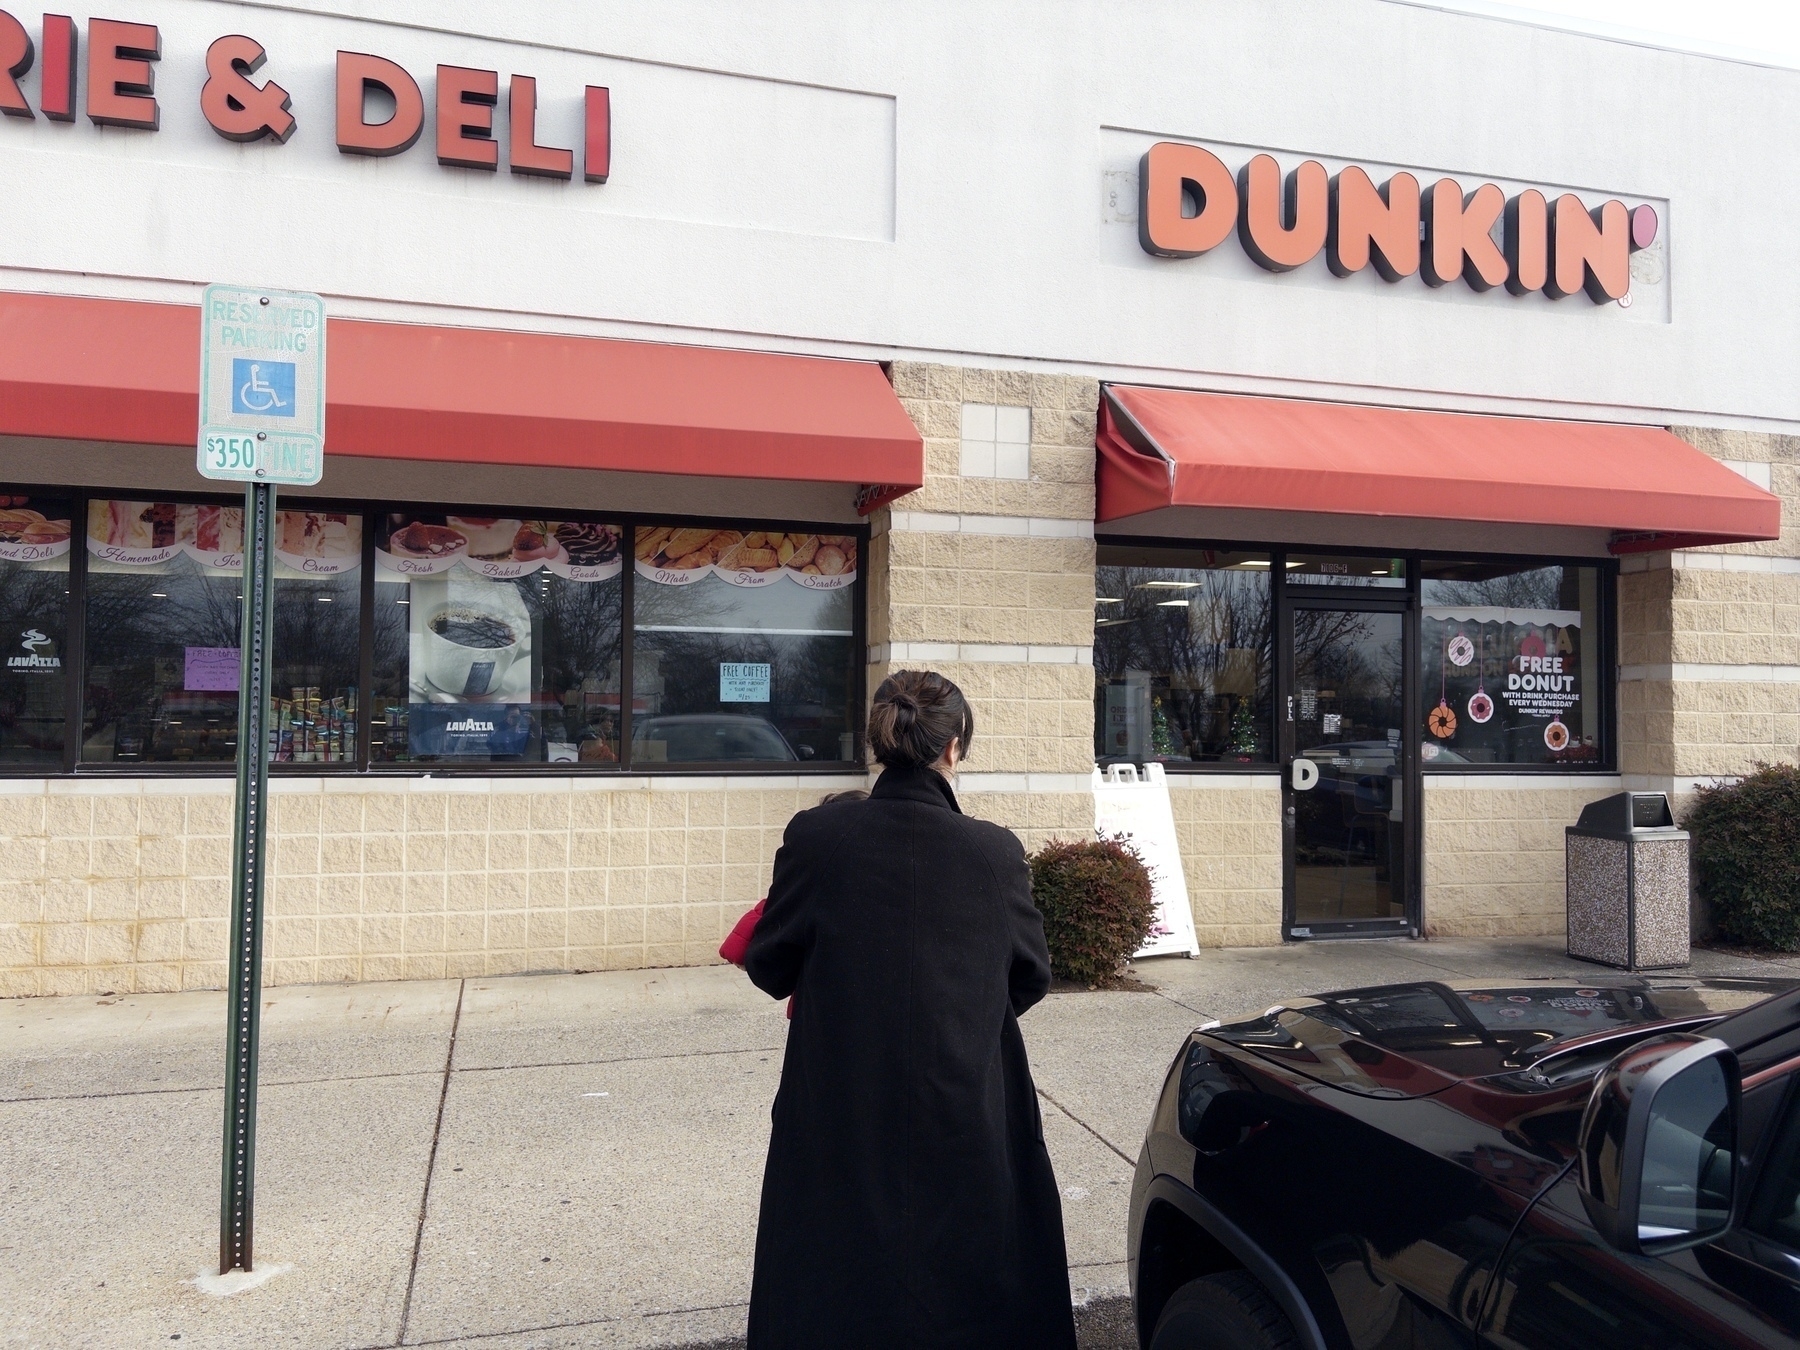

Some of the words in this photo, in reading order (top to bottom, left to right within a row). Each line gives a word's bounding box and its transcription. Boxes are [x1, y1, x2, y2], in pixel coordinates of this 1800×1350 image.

[200, 34, 297, 142] &
[336, 49, 610, 183] DELI
[1139, 141, 1658, 304] DUNKIN'
[213, 301, 316, 329] RESERVED
[221, 325, 307, 353] PARKING
[207, 437, 254, 469] $350
[260, 440, 313, 473] FINE
[22, 546, 55, 560] Deli
[97, 547, 171, 565] Homemade
[213, 554, 242, 568] Ice
[302, 558, 340, 573] Cream
[397, 560, 434, 574] Fresh
[482, 563, 522, 577] Baked
[569, 566, 600, 580] Goods
[655, 570, 690, 583] Made
[734, 573, 766, 585] From
[804, 576, 843, 588] Scratch
[7, 653, 61, 667] LAVAZZA
[218, 650, 241, 658] COFFE
[723, 665, 738, 677] FREE
[743, 665, 768, 678] COFFEE
[1519, 655, 1564, 674] FREE
[1508, 673, 1575, 692] DONUT
[1502, 691, 1521, 699] WITH
[1522, 692, 1543, 700] DRINK
[1544, 693, 1580, 701] PURCHASE
[446, 718, 495, 731] LAVAZZA
[1292, 759, 1319, 791] D
